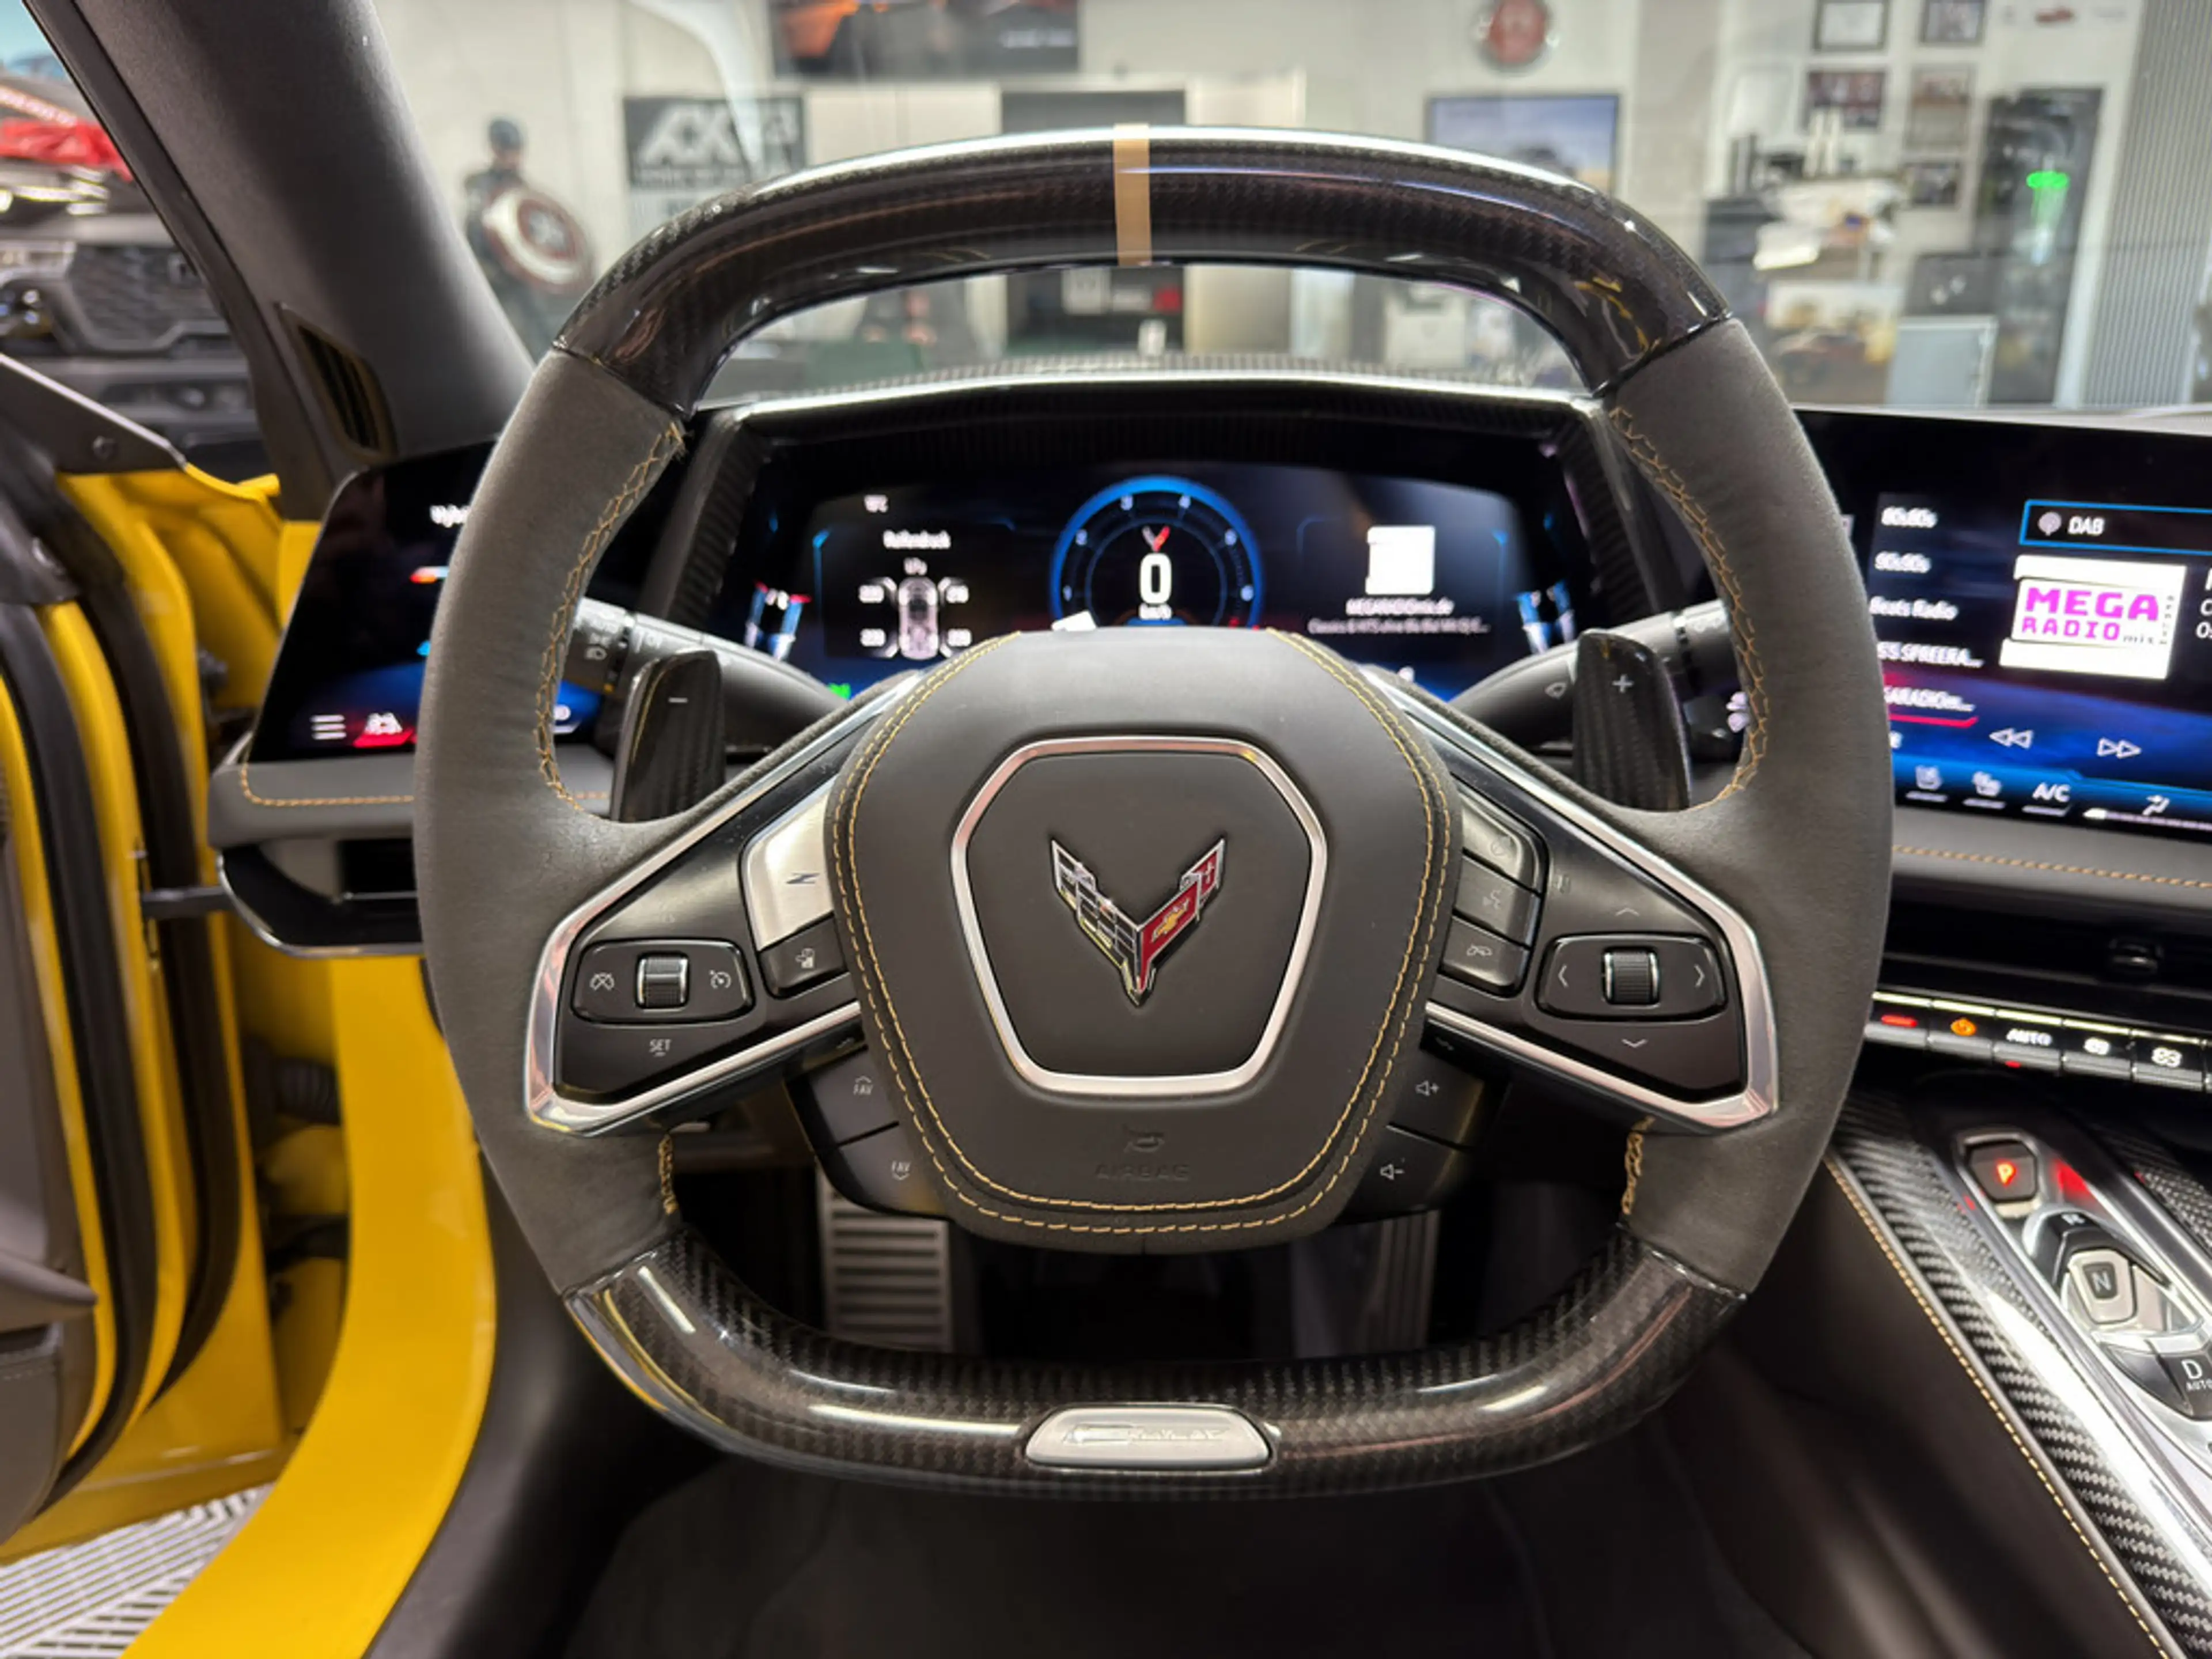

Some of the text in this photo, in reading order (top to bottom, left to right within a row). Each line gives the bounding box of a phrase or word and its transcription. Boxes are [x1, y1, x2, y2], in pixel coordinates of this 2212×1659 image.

[2068, 517, 2104, 535] DAB
[1139, 553, 1172, 604] 0
[2025, 587, 2158, 621] MEGA
[2021, 616, 2120, 641] RADIO
[2032, 782, 2071, 802] A/C
[649, 1039, 672, 1052] SET
[2006, 1029, 2052, 1046] AUTO
[853, 1084, 874, 1096] FAV
[891, 1160, 911, 1172] FAV
[1996, 1162, 2016, 1184] P
[2093, 1272, 2111, 1291] N
[2181, 1359, 2202, 1379] D
